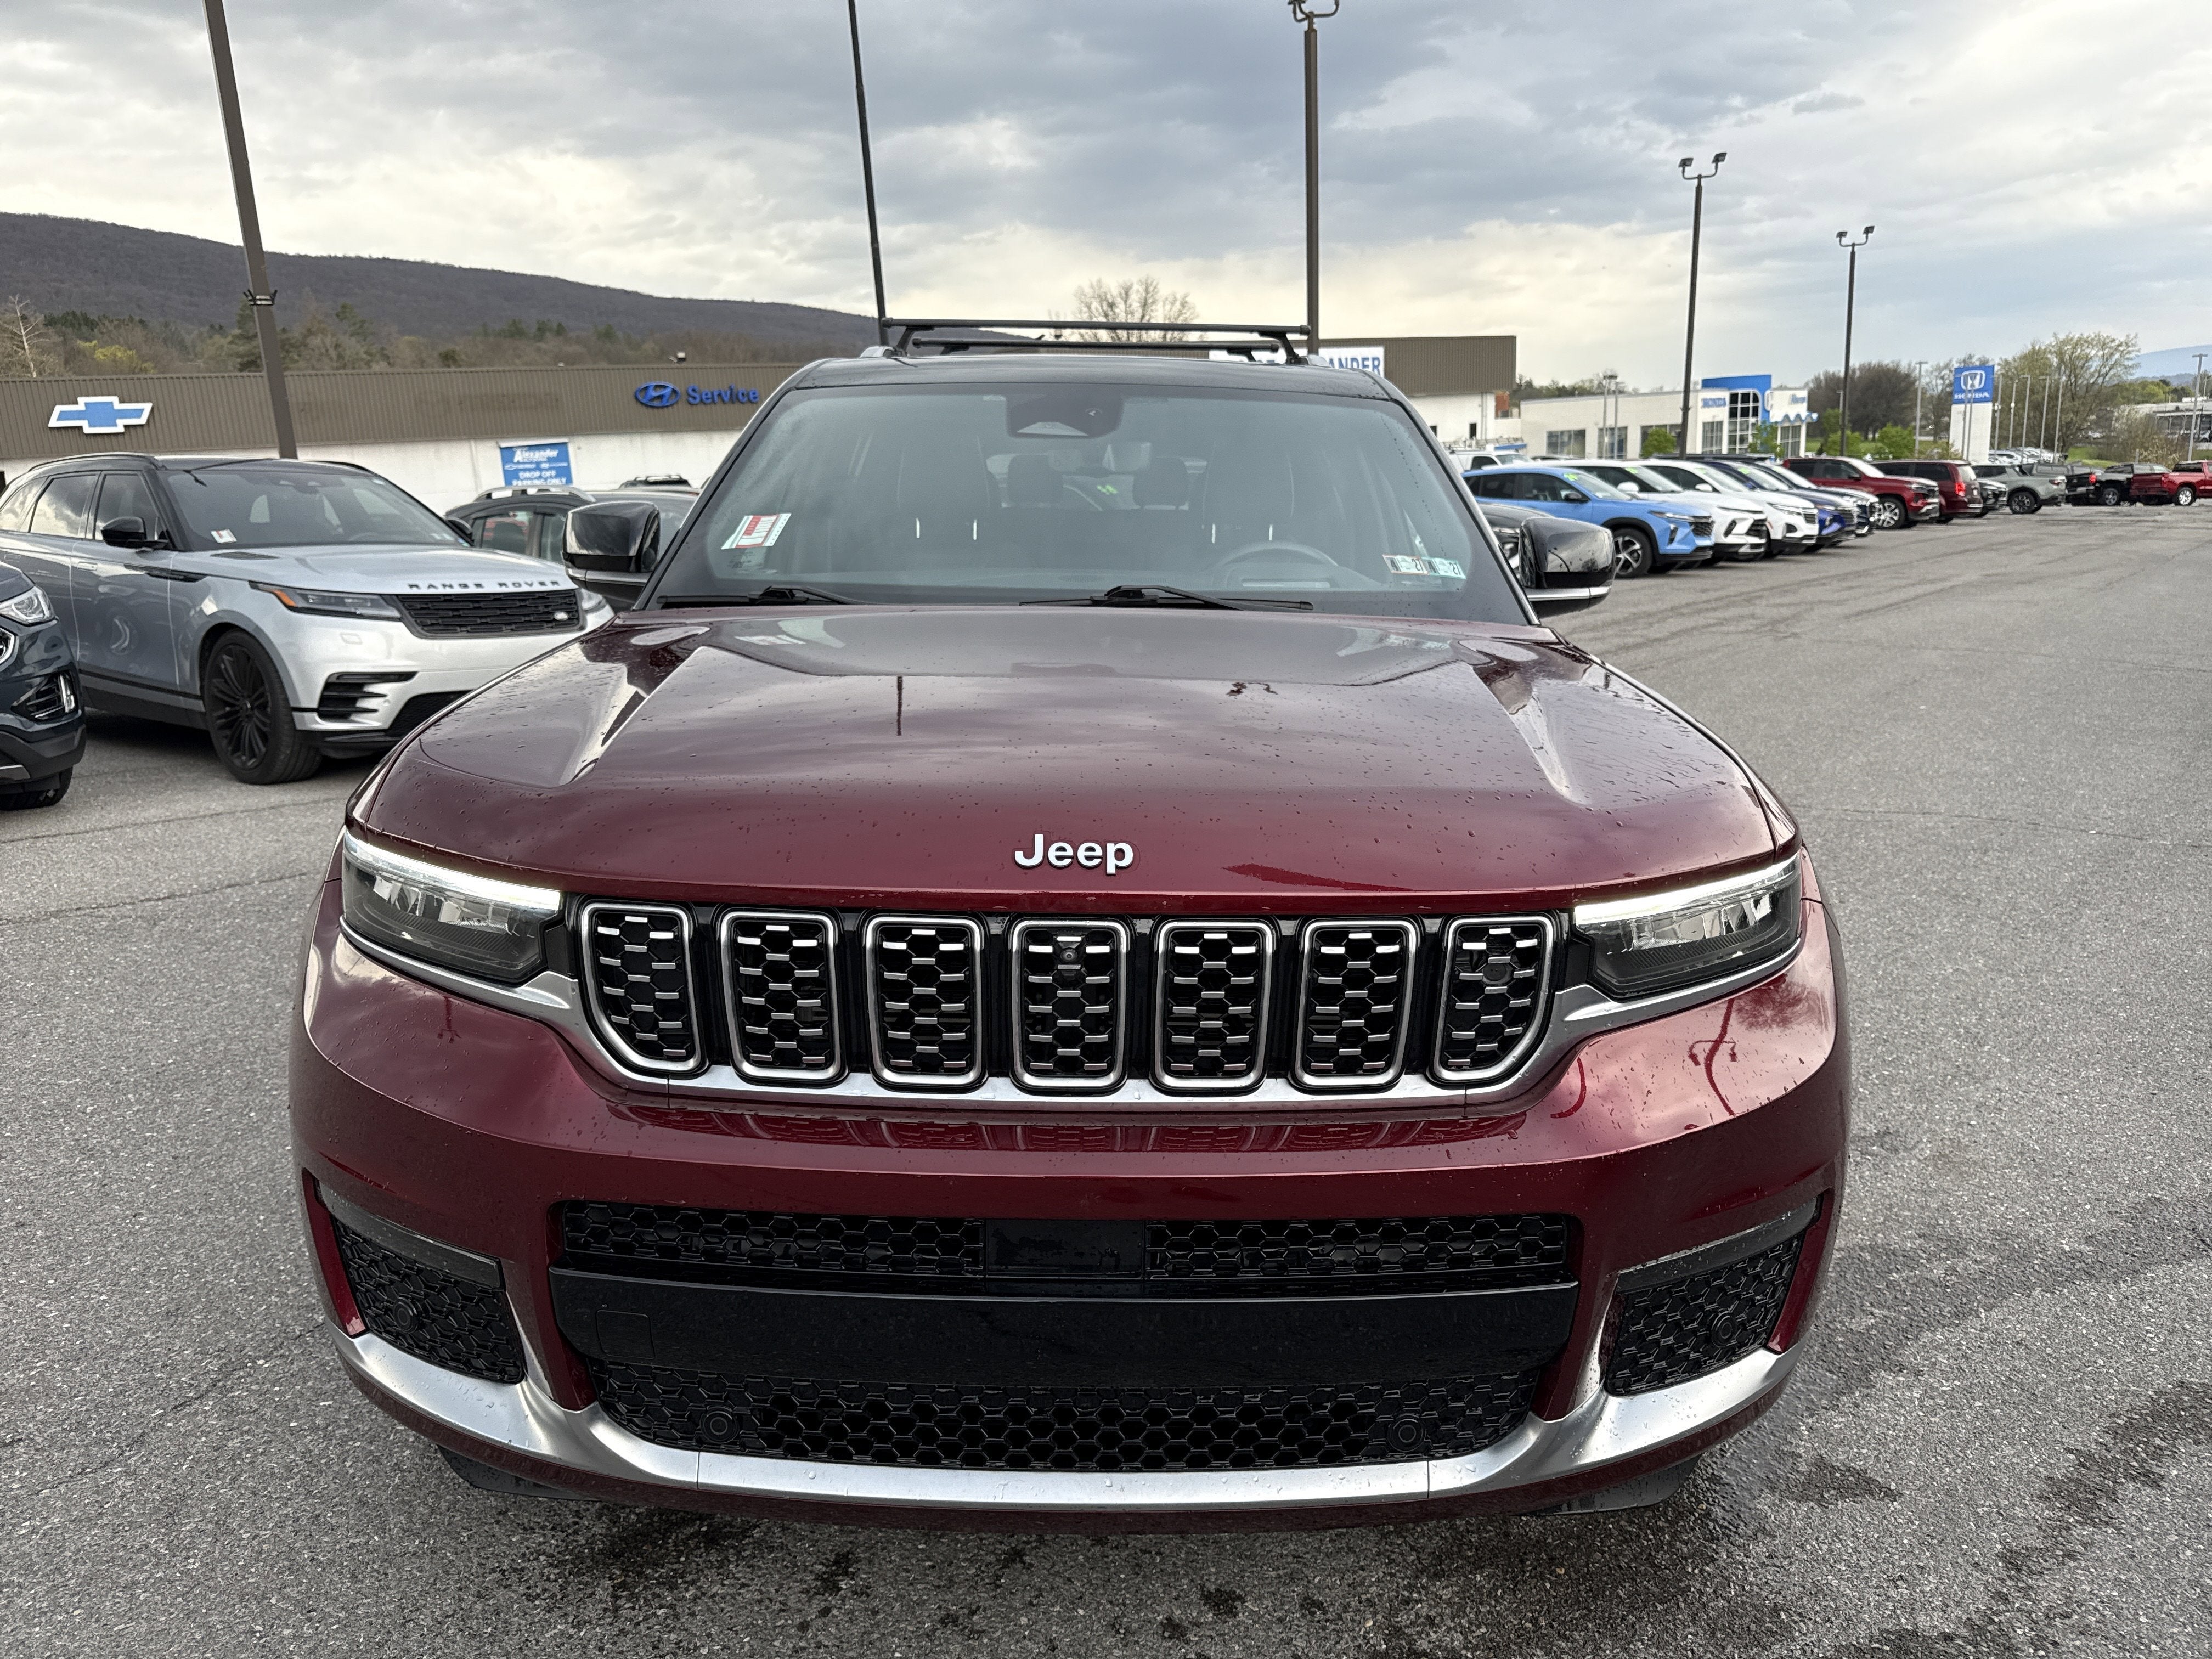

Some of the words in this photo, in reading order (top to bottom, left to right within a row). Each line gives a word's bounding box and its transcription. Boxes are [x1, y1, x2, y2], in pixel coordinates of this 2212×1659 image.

[687, 383, 759, 405] Service
[514, 448, 559, 462] Alexander
[518, 471, 540, 479] DROP
[541, 470, 557, 478] OFF
[497, 580, 560, 589] ROVER
[1014, 833, 1134, 875] Jeep
